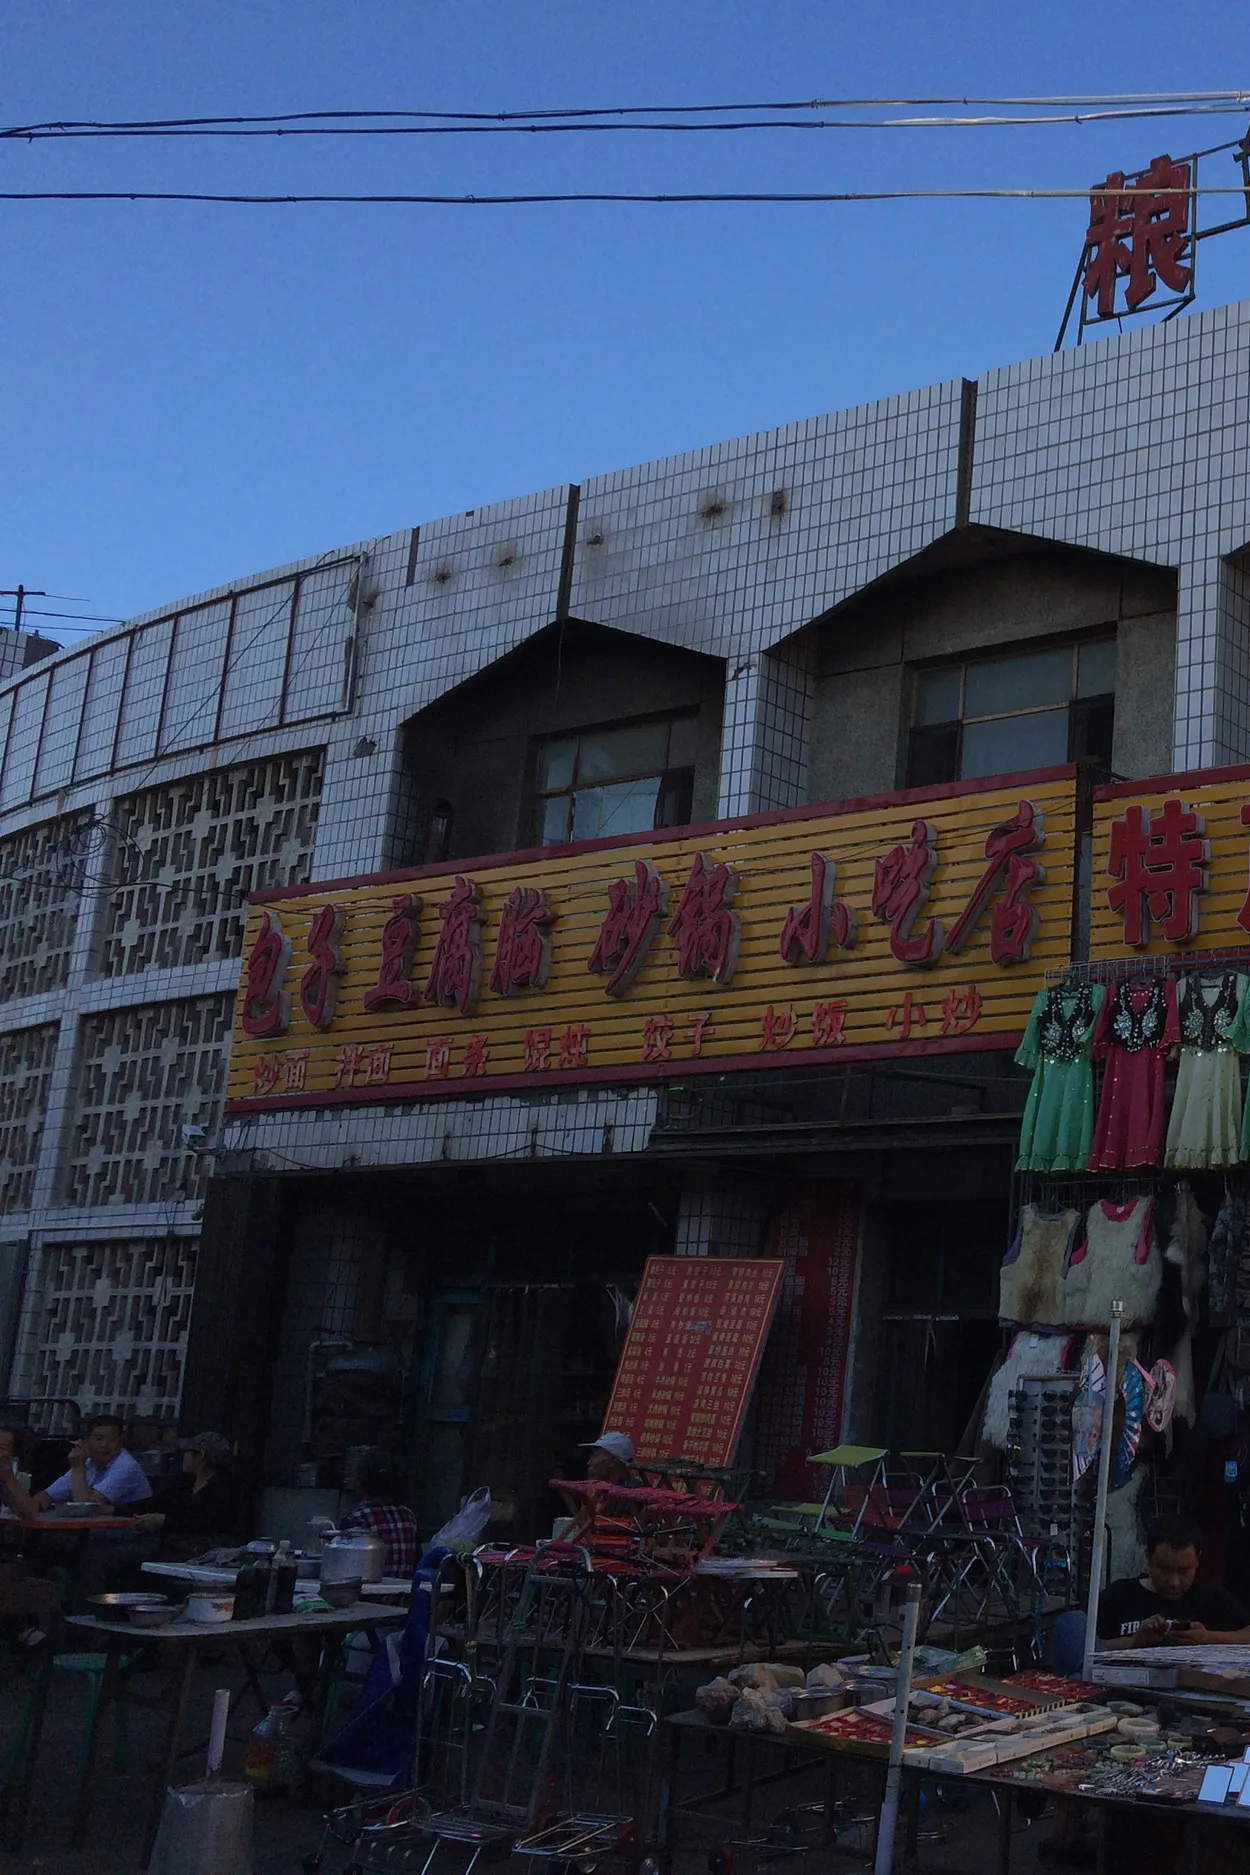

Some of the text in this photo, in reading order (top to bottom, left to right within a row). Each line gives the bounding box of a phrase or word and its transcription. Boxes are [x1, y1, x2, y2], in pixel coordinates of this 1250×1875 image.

[427, 1035, 488, 1076] 面条
[643, 1011, 715, 1060] 饺子
[760, 999, 847, 1049] 炒饭
[885, 985, 982, 1038] 小炒
